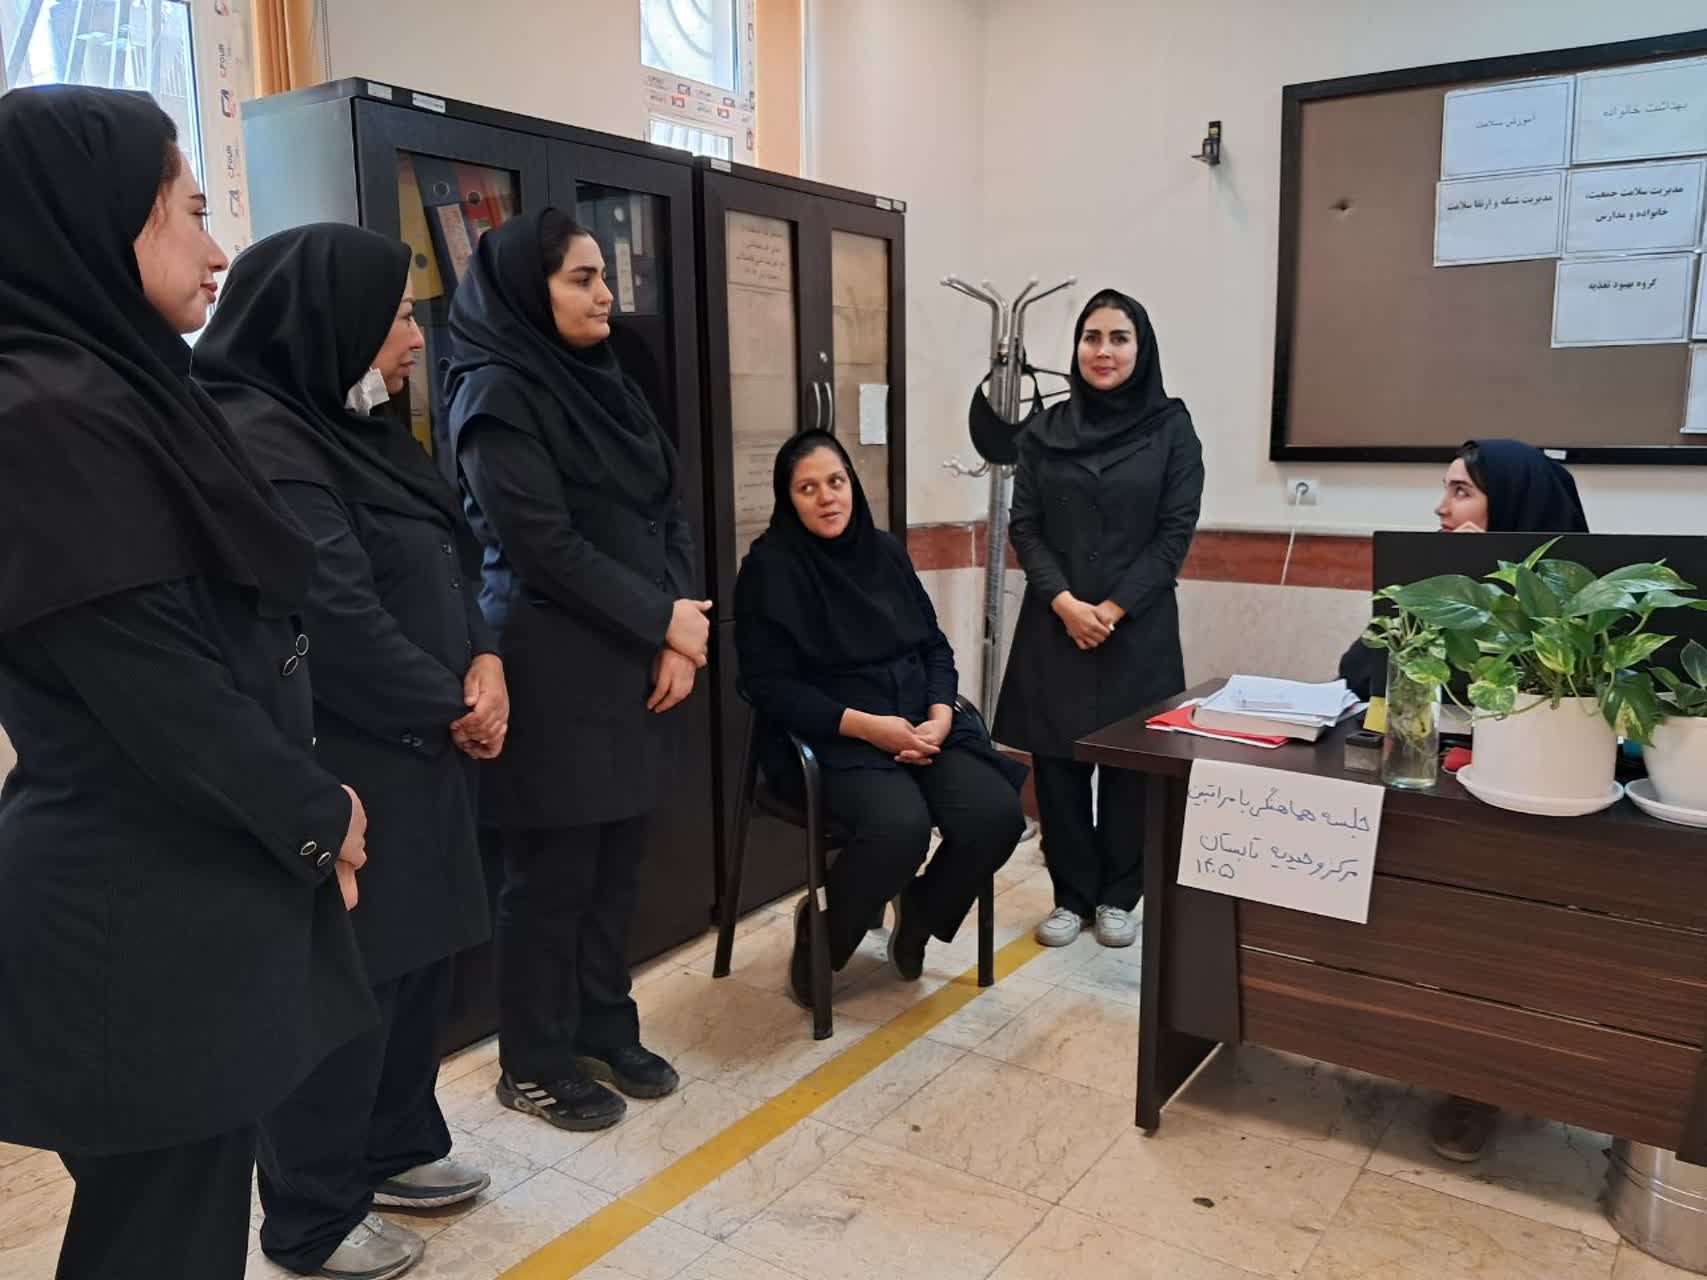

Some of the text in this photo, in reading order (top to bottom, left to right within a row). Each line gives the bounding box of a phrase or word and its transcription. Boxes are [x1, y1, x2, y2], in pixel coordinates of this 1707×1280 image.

[1602, 99, 1688, 120] بهداشت خانواده
[1619, 186, 1649, 199] سلامت
[1649, 184, 1684, 199] مدیریت
[1446, 199, 1472, 211] سلامت
[1520, 194, 1553, 207] مدیریت
[1595, 210, 1626, 223] مدارس
[1636, 207, 1669, 221] خانواده
[1635, 276, 1657, 292] گروه
[1239, 788, 1250, 814] با
[1321, 807, 1370, 839] جلسه
[1199, 832, 1262, 863] تابستان
[1196, 858, 1236, 880] ۱۴۰۵
[1320, 858, 1360, 882] مرکز
